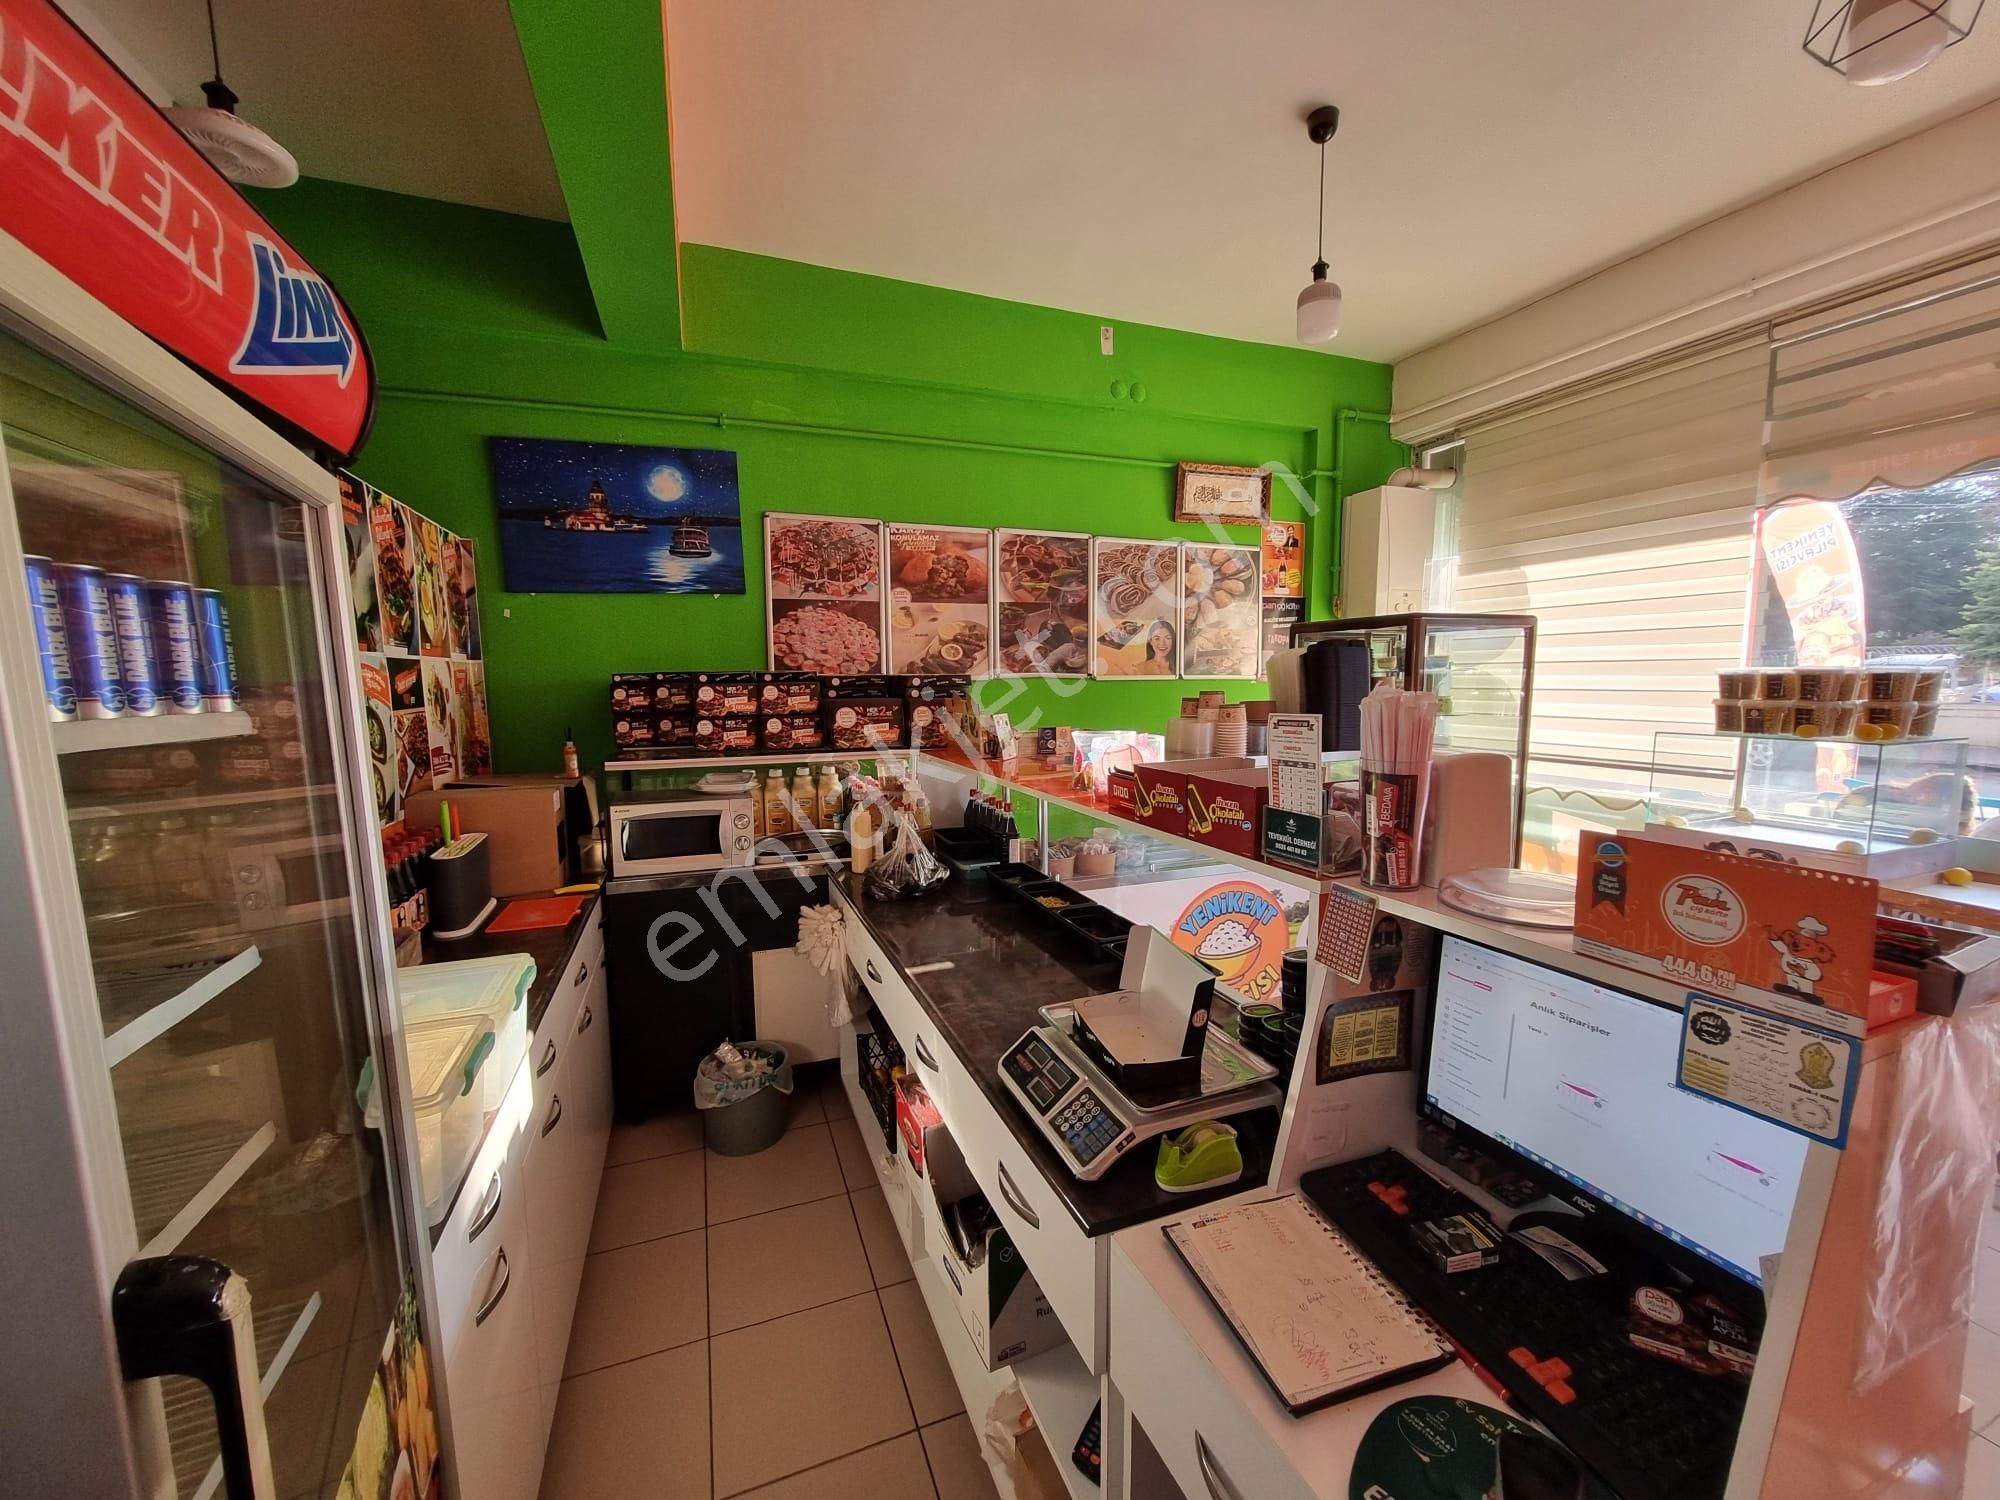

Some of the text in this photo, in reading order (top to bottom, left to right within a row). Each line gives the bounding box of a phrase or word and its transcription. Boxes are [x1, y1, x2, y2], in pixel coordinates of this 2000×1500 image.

[38, 577, 71, 680] DARK BLUE
[88, 585, 120, 681] DARK BLUE
[113, 594, 149, 682] DARK BLUE
[164, 599, 195, 682] DARK BLUE
[1380, 786, 1393, 820] BEDAVA
[1267, 832, 1293, 844] TEVEKKÜL
[1676, 883, 1731, 912] Pan
[1662, 955, 1697, 979] 444
[1700, 965, 1713, 983] 6
[1530, 1001, 1612, 1038] Anlık Siparişler
